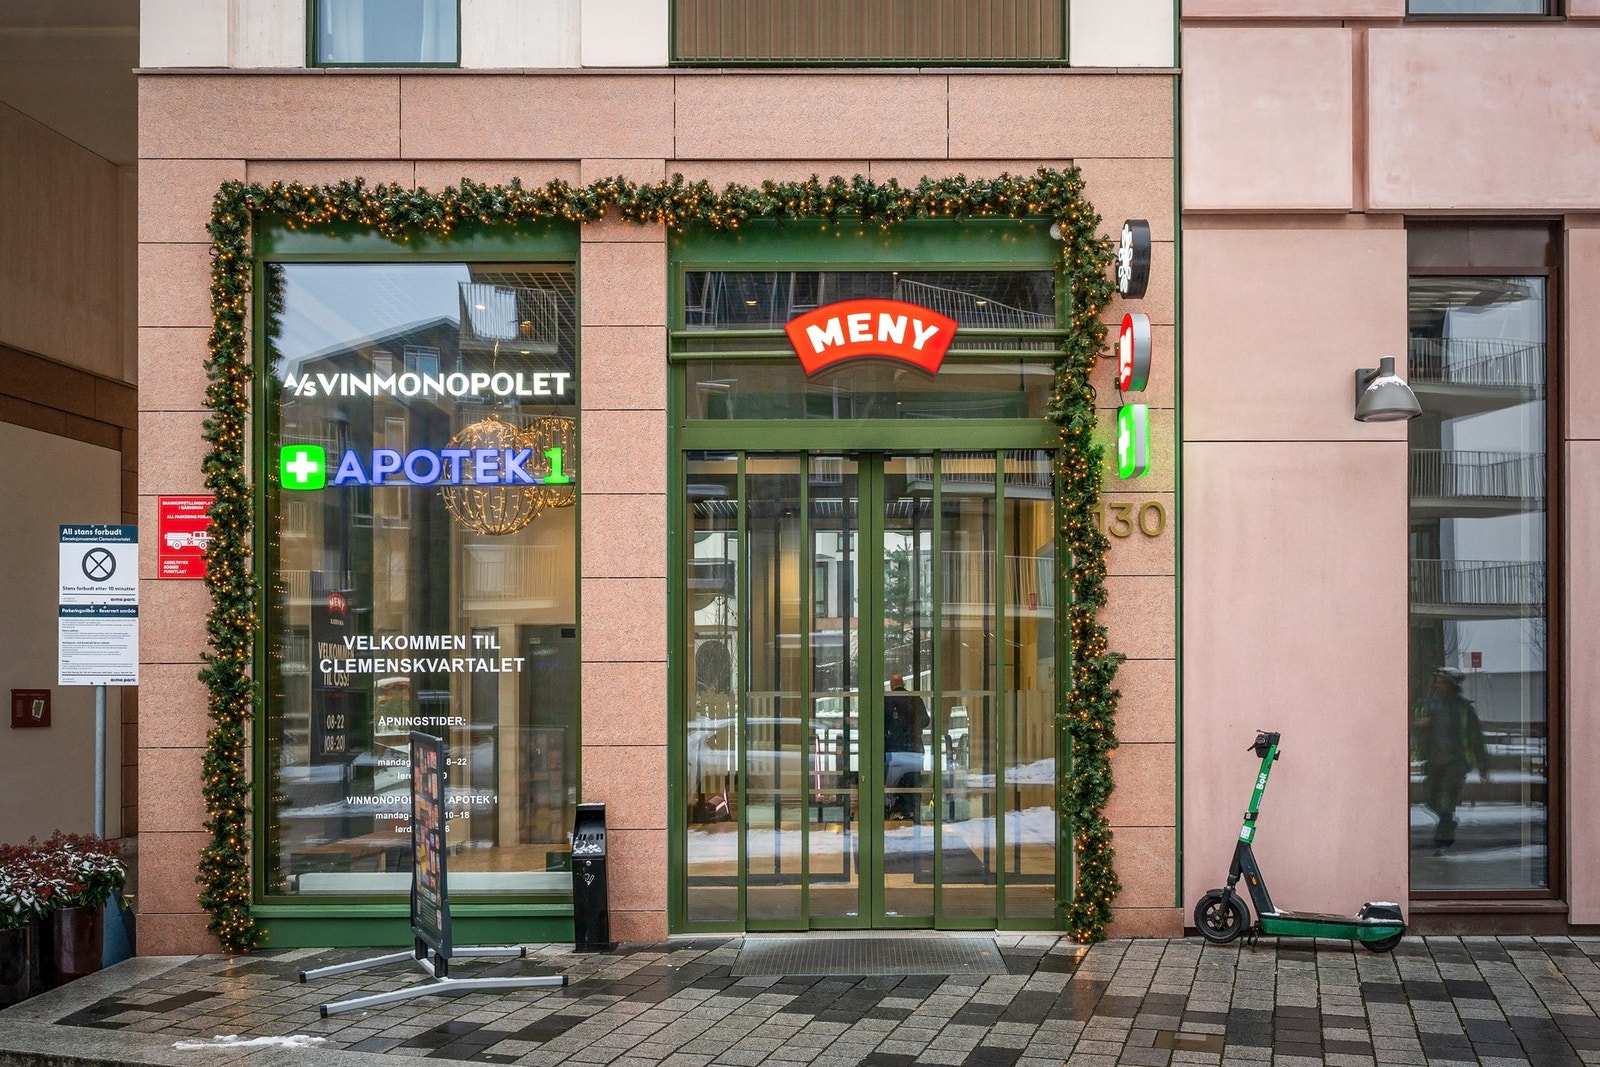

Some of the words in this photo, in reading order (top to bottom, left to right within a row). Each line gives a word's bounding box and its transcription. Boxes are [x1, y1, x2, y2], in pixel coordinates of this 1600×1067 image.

[805, 312, 940, 354] MENY
[316, 372, 570, 396] VINMONOPOLET
[333, 448, 536, 485] APOTEK
[544, 446, 570, 484] 1
[1091, 500, 1167, 538] 130
[329, 596, 346, 612] MENY
[343, 635, 466, 650] VELKOMMEN
[472, 635, 501, 650] TIL
[319, 657, 526, 673] CLEMENSKVARTALET
[326, 714, 345, 730] 08-22
[378, 715, 466, 726] ÅPNINGSTIDER:
[378, 758, 411, 767] mandag
[1256, 772, 1267, 790] Bolt
[448, 795, 490, 804] APOTEK
[493, 796, 497, 804] 1
[375, 812, 412, 820] mandag-
[395, 825, 412, 833] lørd
